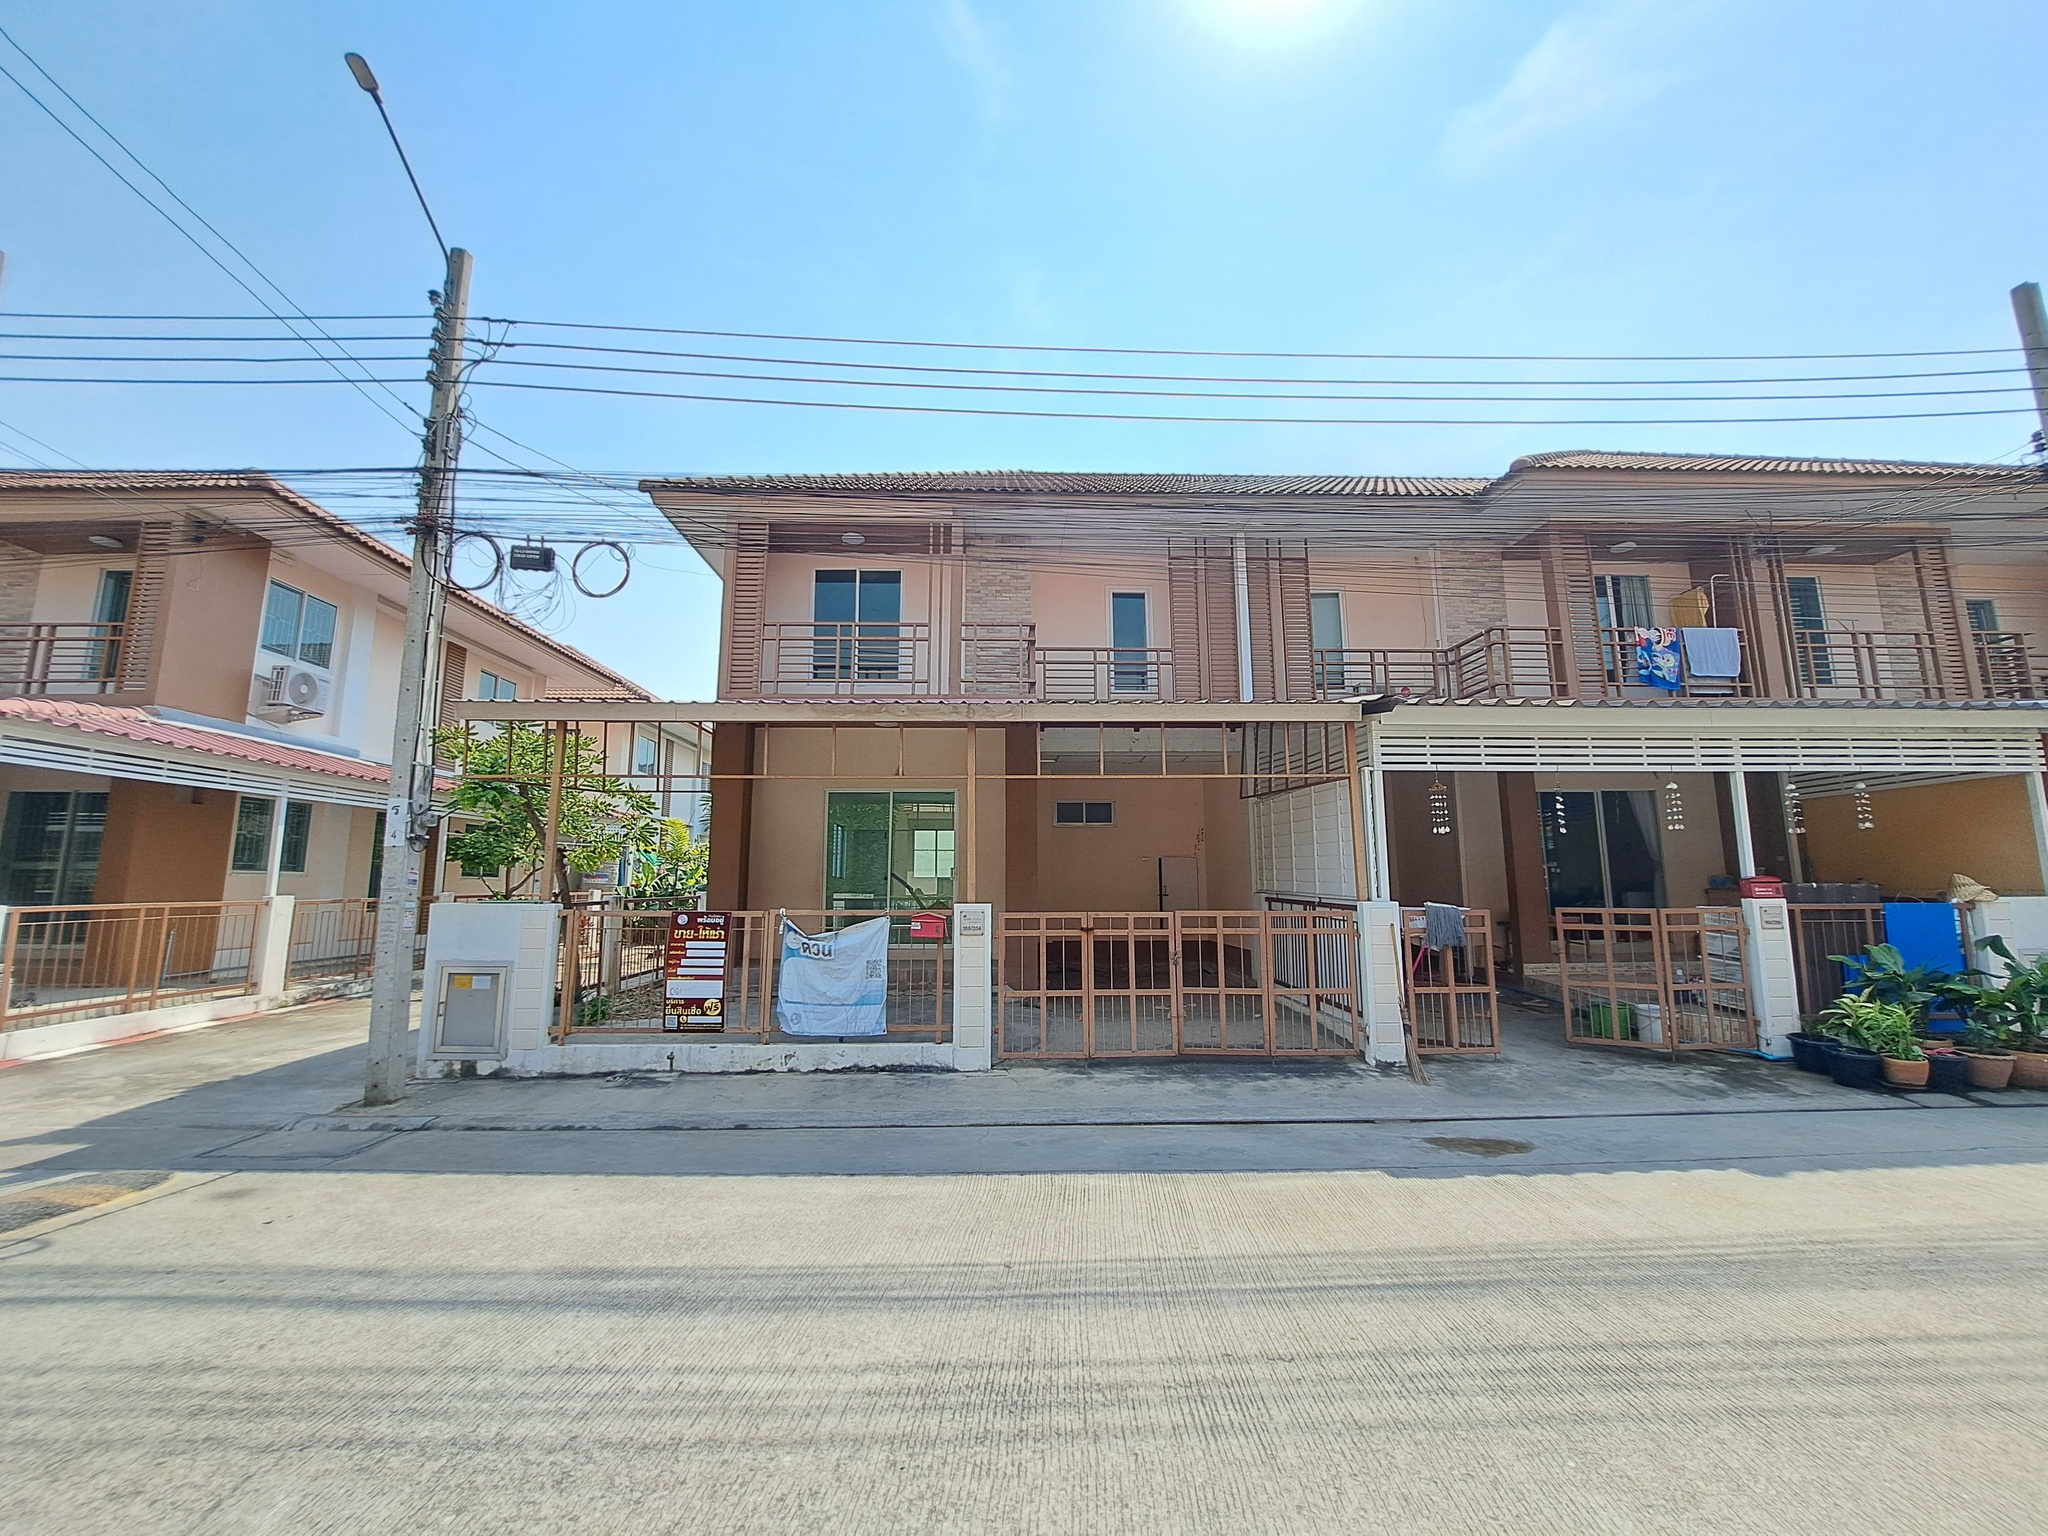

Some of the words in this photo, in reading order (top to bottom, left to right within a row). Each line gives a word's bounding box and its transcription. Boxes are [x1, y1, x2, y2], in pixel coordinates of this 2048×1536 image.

[673, 925, 725, 939] ขาย-ให้เช่า
[801, 939, 833, 957] ดวน
